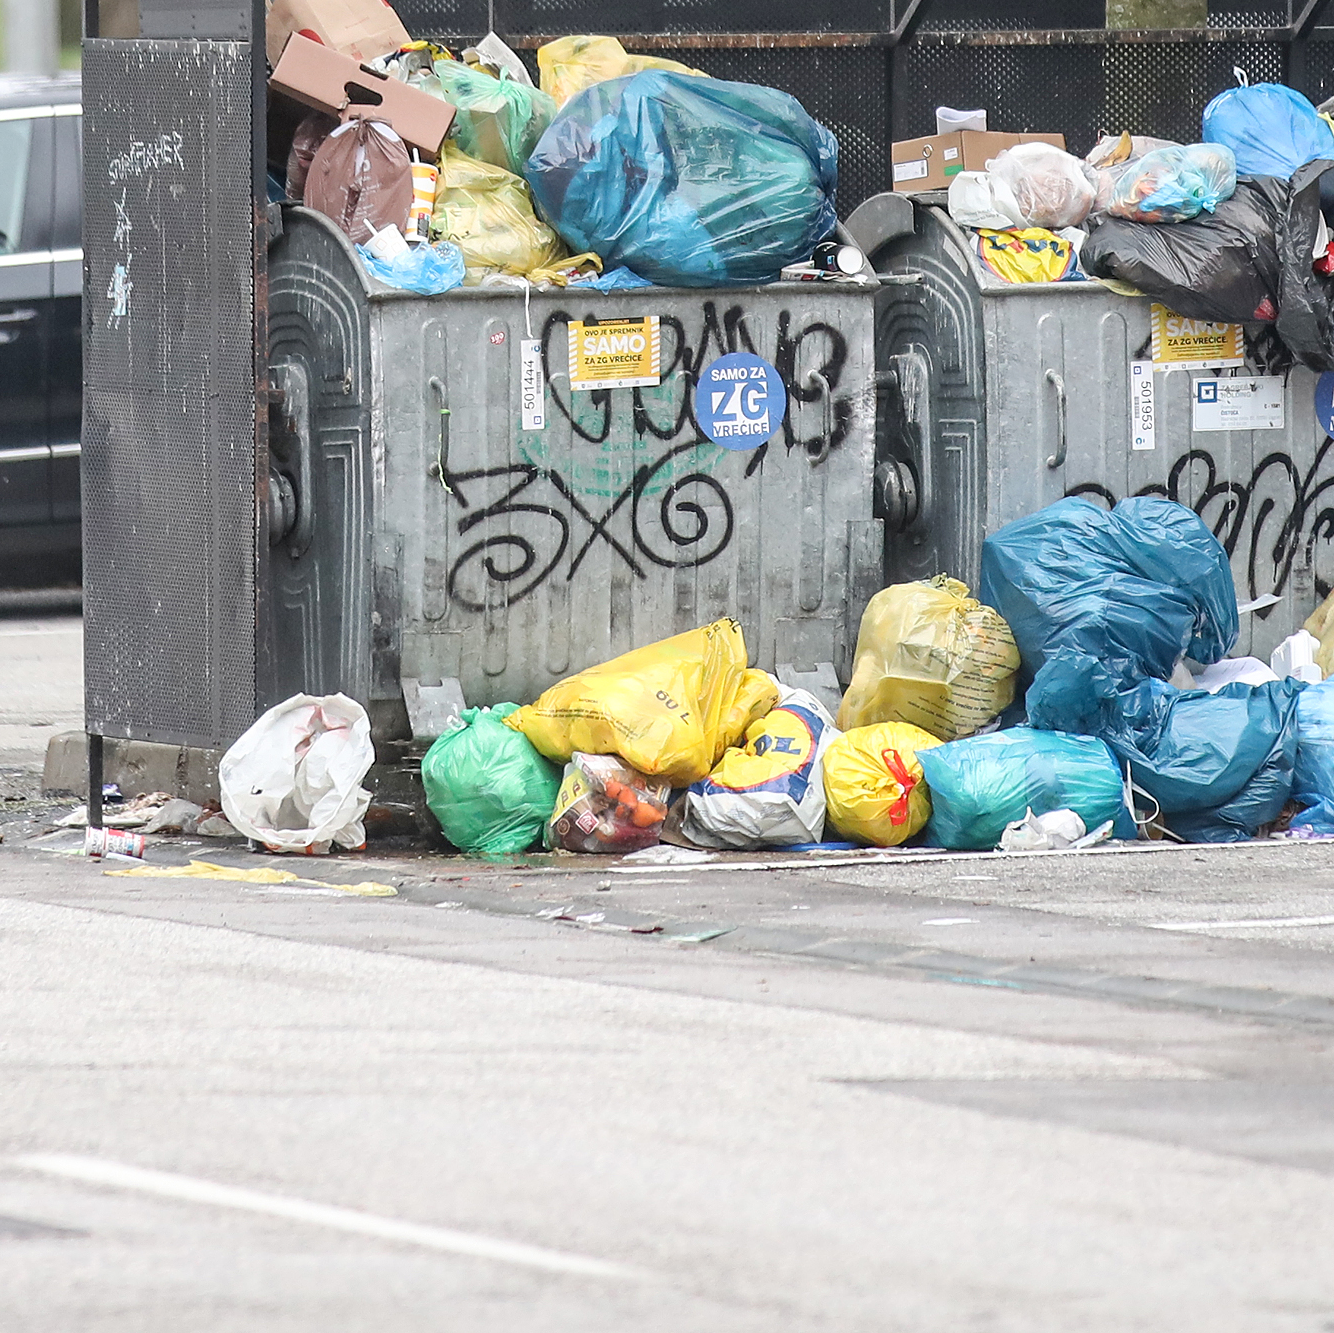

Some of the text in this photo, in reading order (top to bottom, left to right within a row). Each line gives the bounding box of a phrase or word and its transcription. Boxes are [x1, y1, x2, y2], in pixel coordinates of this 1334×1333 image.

[609, 327, 644, 335] SPREMNIK
[583, 335, 646, 355] SAMO
[584, 357, 595, 365] ZA
[597, 356, 608, 364] ZG
[711, 366, 767, 381] SAMO ZA
[524, 360, 535, 410] 501444
[712, 381, 768, 422] ZG
[1141, 381, 1153, 431] 501953
[713, 419, 769, 437] VREĆICE
